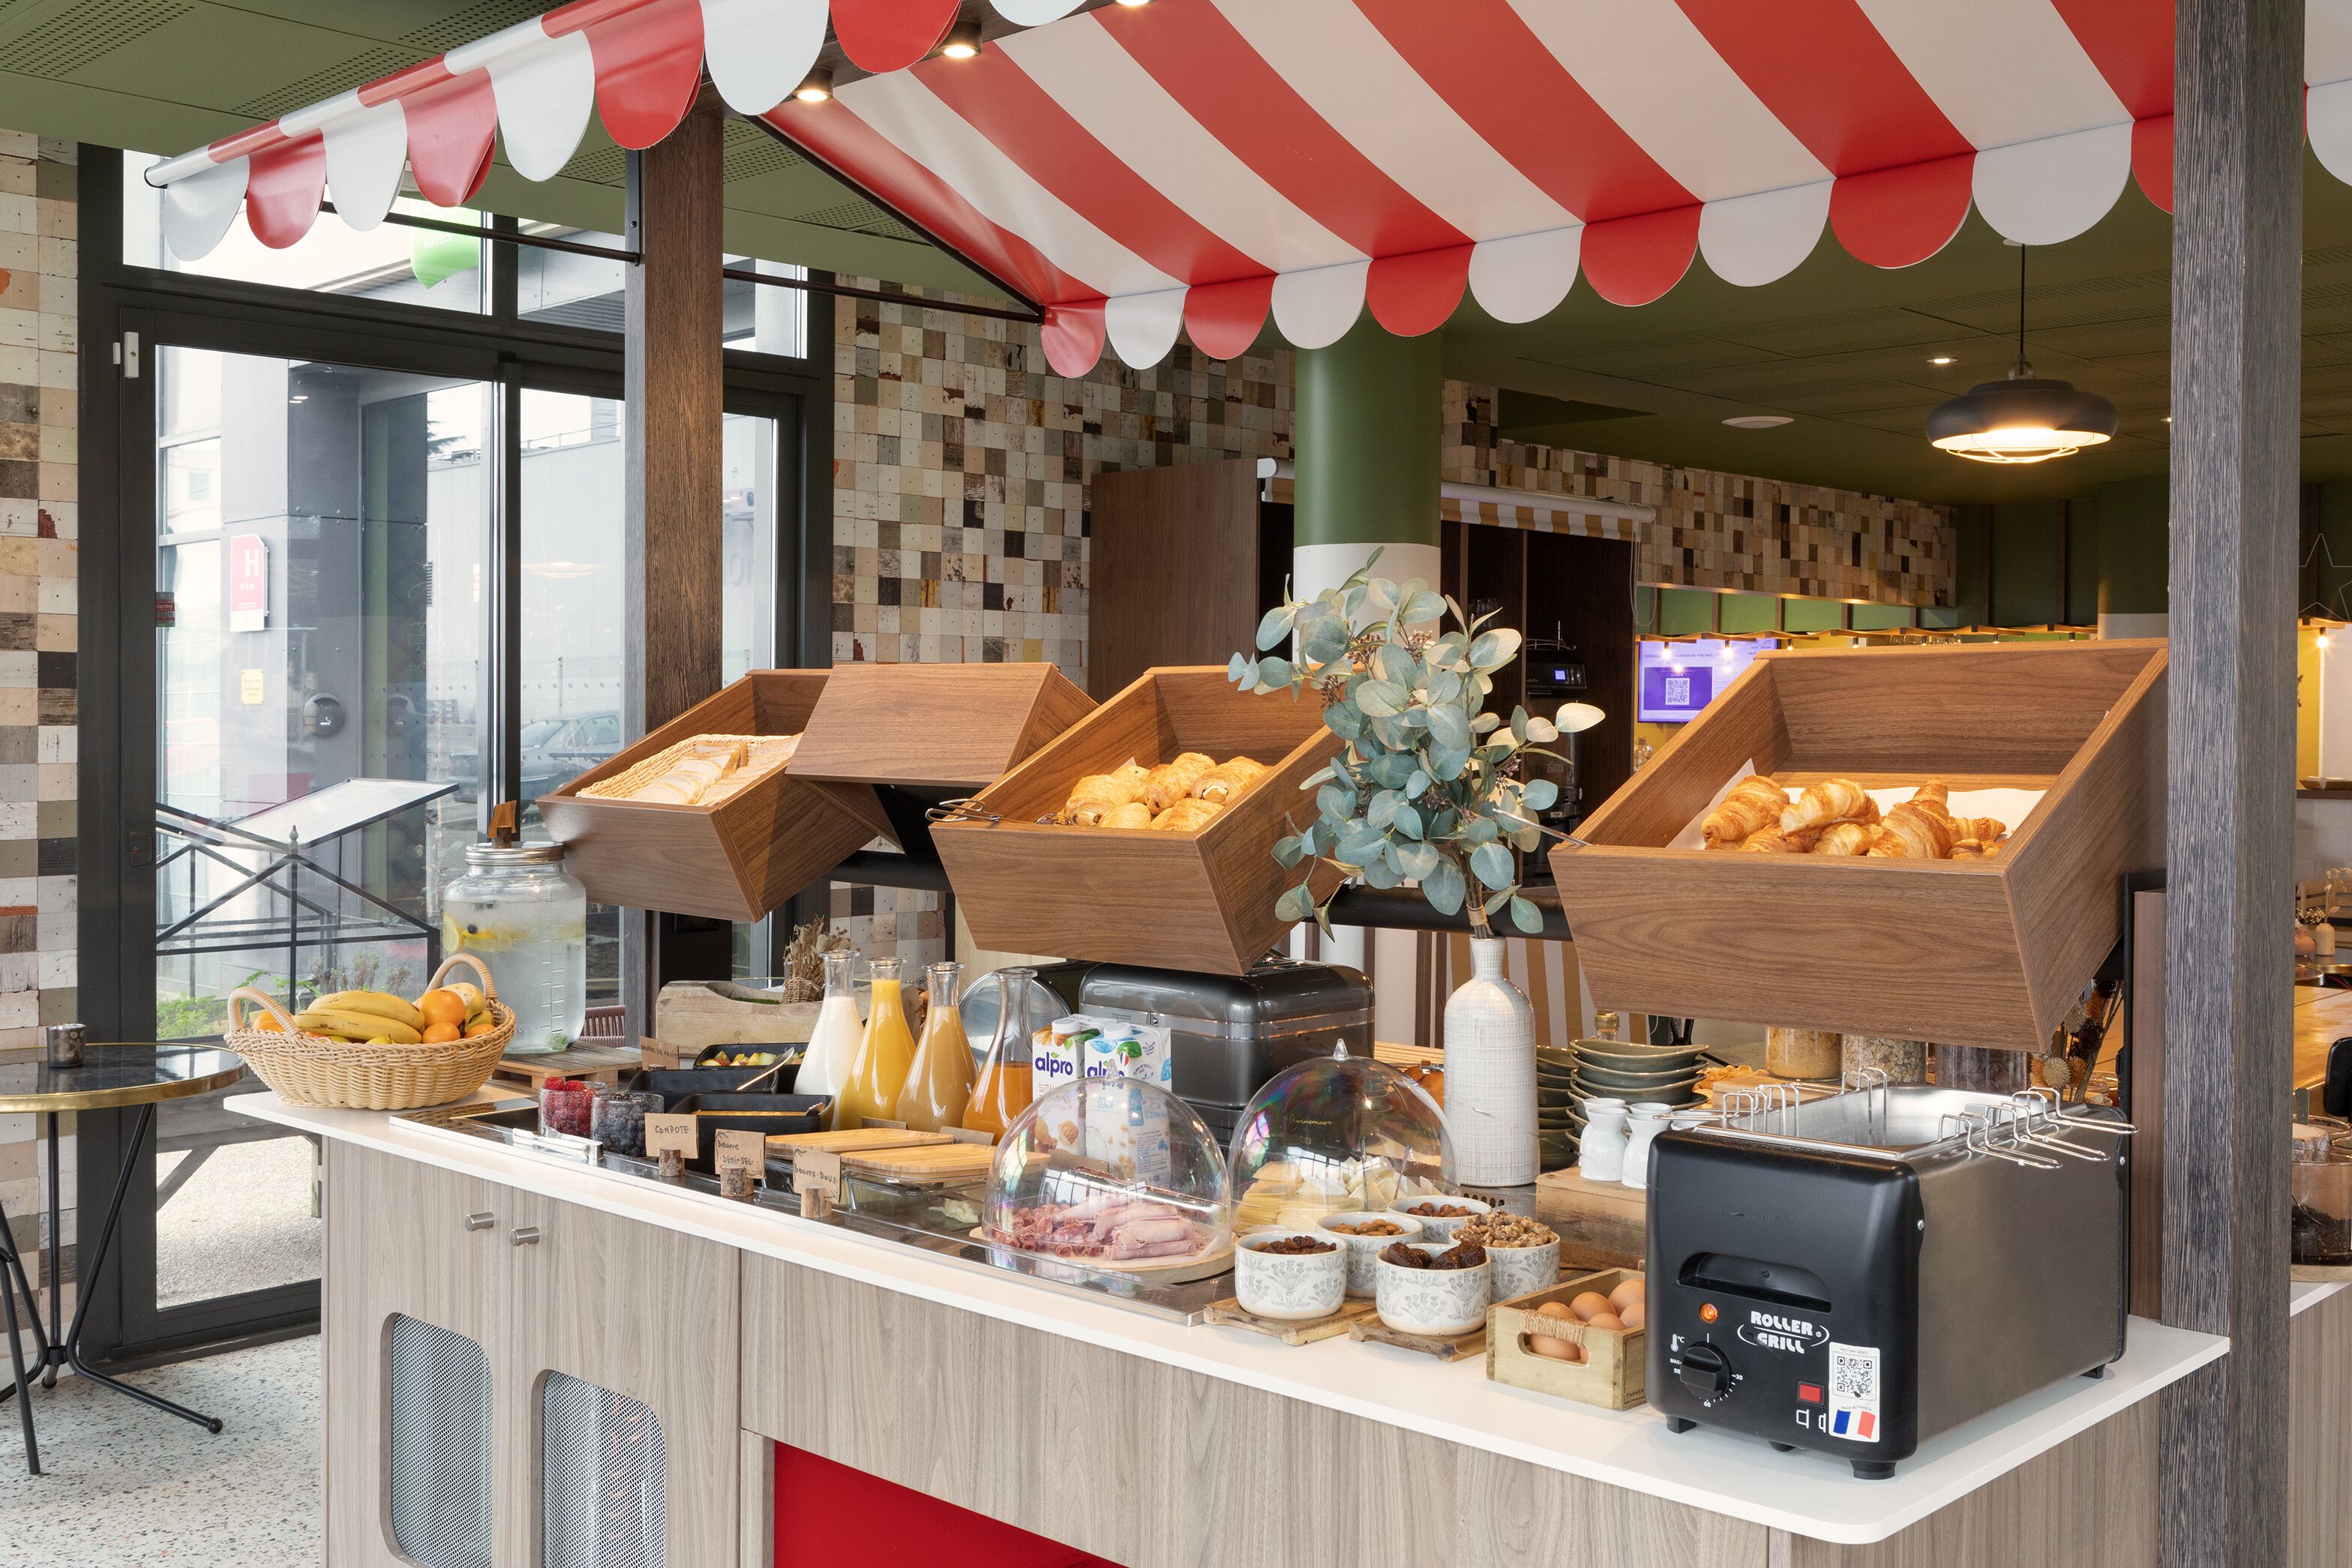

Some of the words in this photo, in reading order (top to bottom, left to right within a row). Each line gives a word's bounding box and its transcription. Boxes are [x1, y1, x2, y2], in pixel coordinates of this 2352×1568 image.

[244, 550, 260, 577] H
[1035, 1052, 1073, 1078] alpro
[1750, 1310, 1813, 1336] ROLLER
[1756, 1332, 1804, 1354] GRILL
